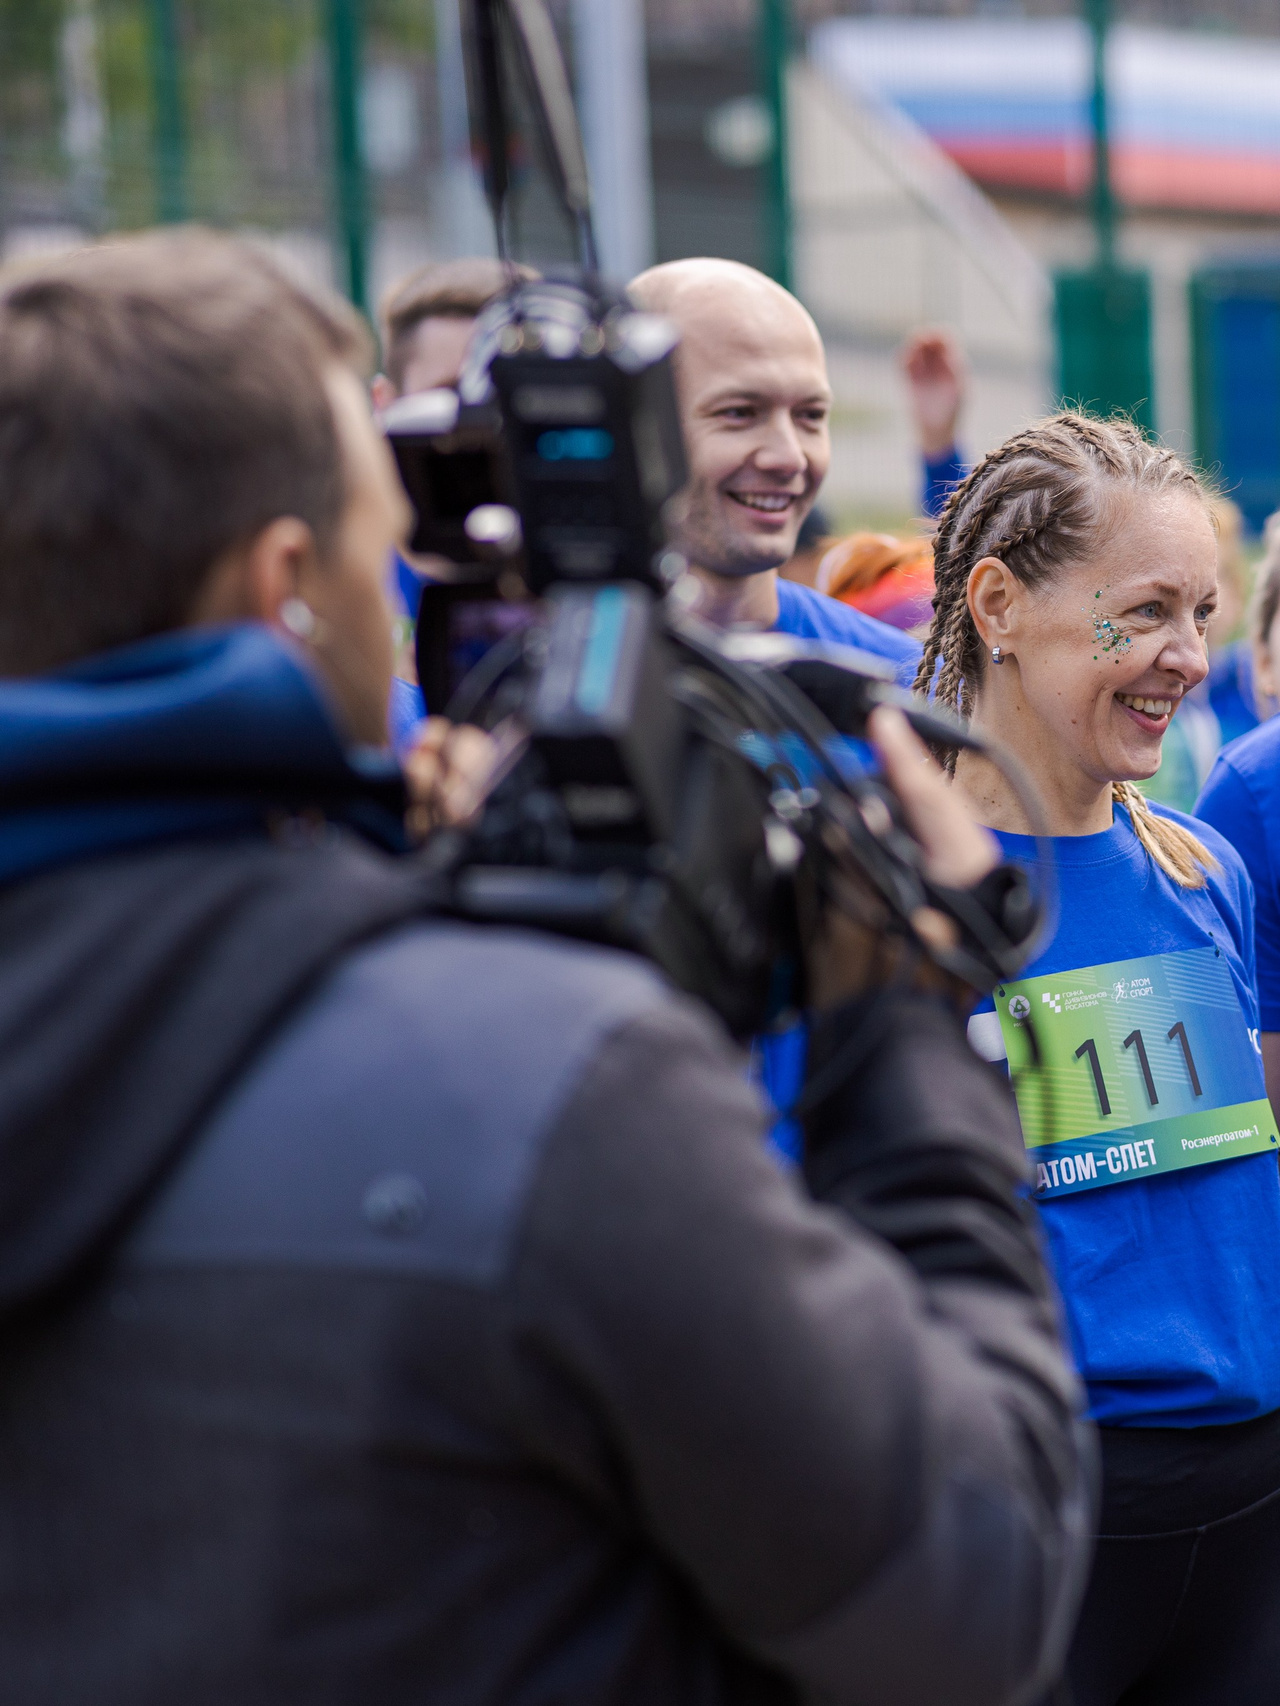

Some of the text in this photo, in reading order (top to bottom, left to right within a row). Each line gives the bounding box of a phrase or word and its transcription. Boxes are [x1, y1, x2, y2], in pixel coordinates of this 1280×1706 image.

[1130, 977, 1151, 989] АТОМ
[1130, 986, 1154, 998] СПОРТ
[1065, 1000, 1099, 1011] РОСАТОМА
[1074, 1021, 1203, 1116] 111
[1181, 1125, 1259, 1150] Росэнергоатом-1
[1036, 1138, 1158, 1190] АТОМ-СЛЕТ
